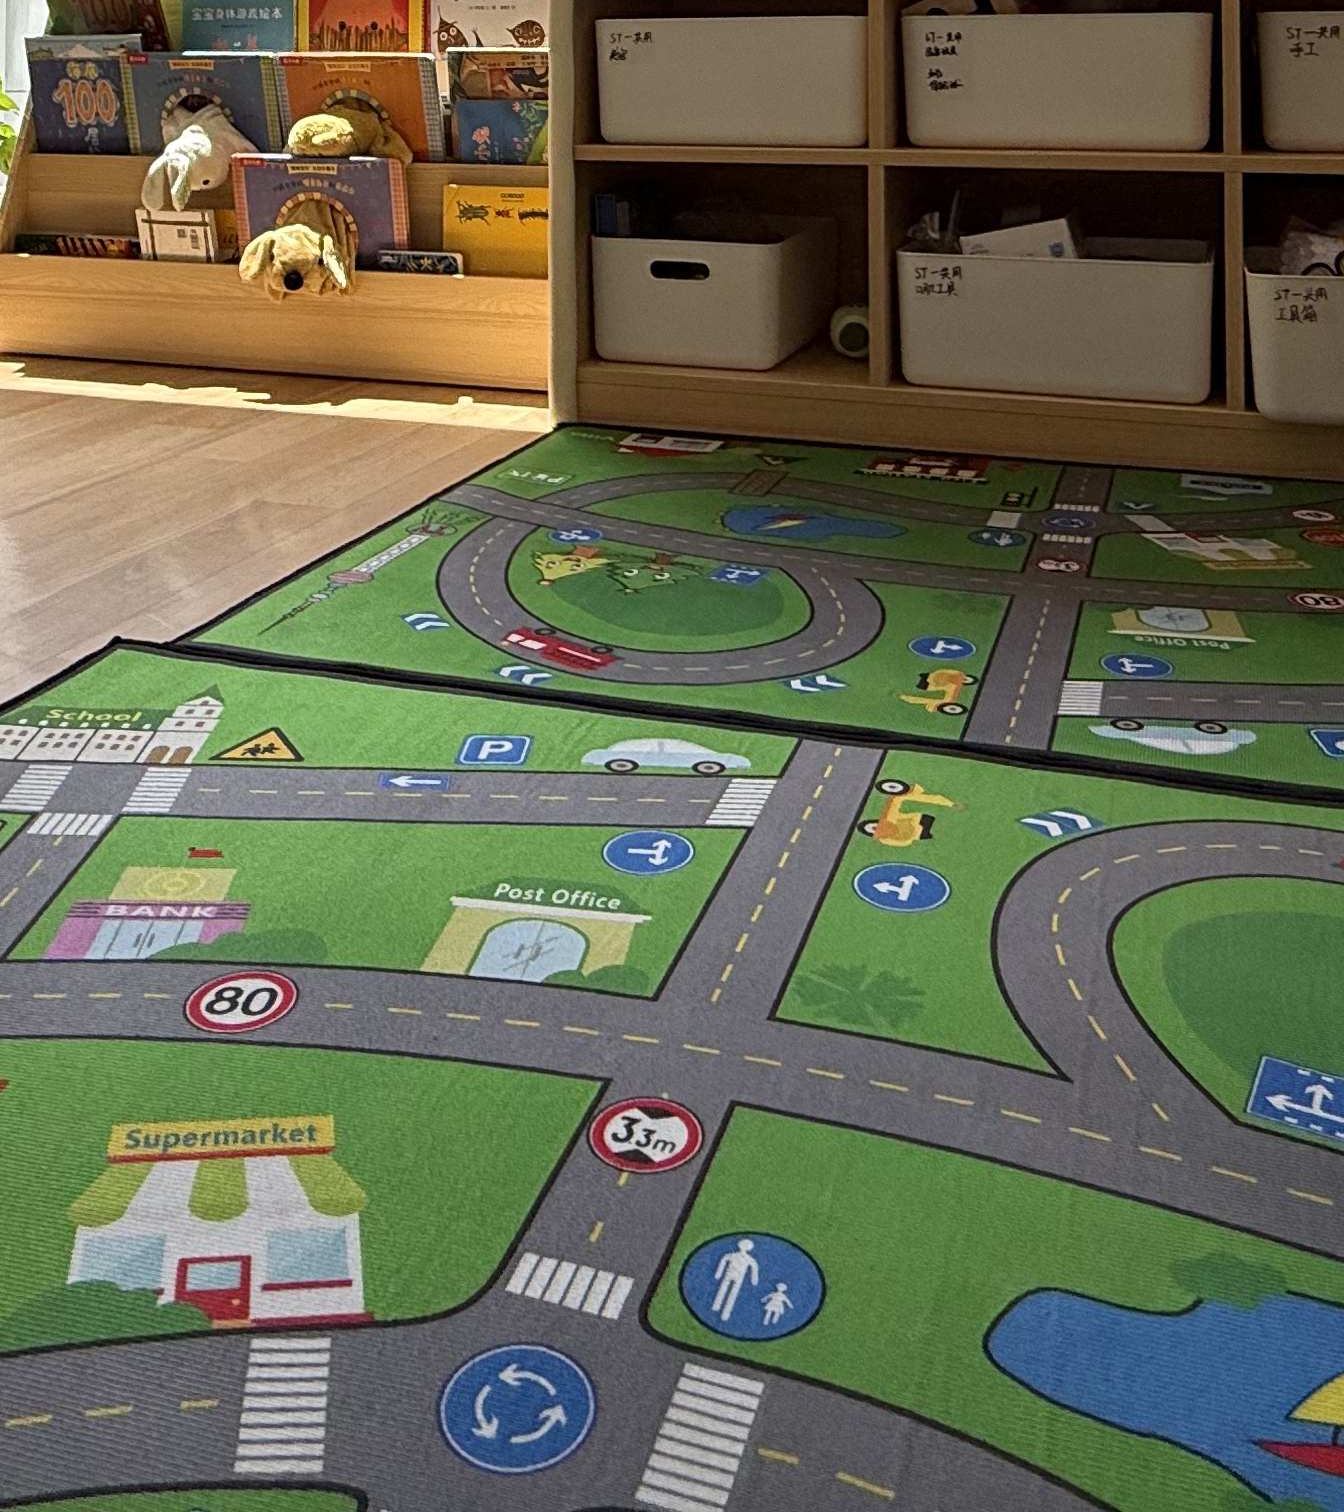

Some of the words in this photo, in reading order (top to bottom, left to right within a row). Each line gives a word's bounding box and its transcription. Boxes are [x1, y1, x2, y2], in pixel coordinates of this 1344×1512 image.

[1289, 41, 1320, 58] 手工
[52, 79, 121, 128] 100
[1299, 595, 1341, 606] 80
[1135, 635, 1187, 647] Office
[1193, 638, 1231, 650] Post
[45, 708, 142, 724] School
[478, 740, 513, 760] P
[494, 882, 544, 904] Post
[551, 885, 621, 911] Office
[106, 904, 218, 919] BANK
[204, 987, 278, 1017] 80
[123, 1122, 317, 1154] Supermarket
